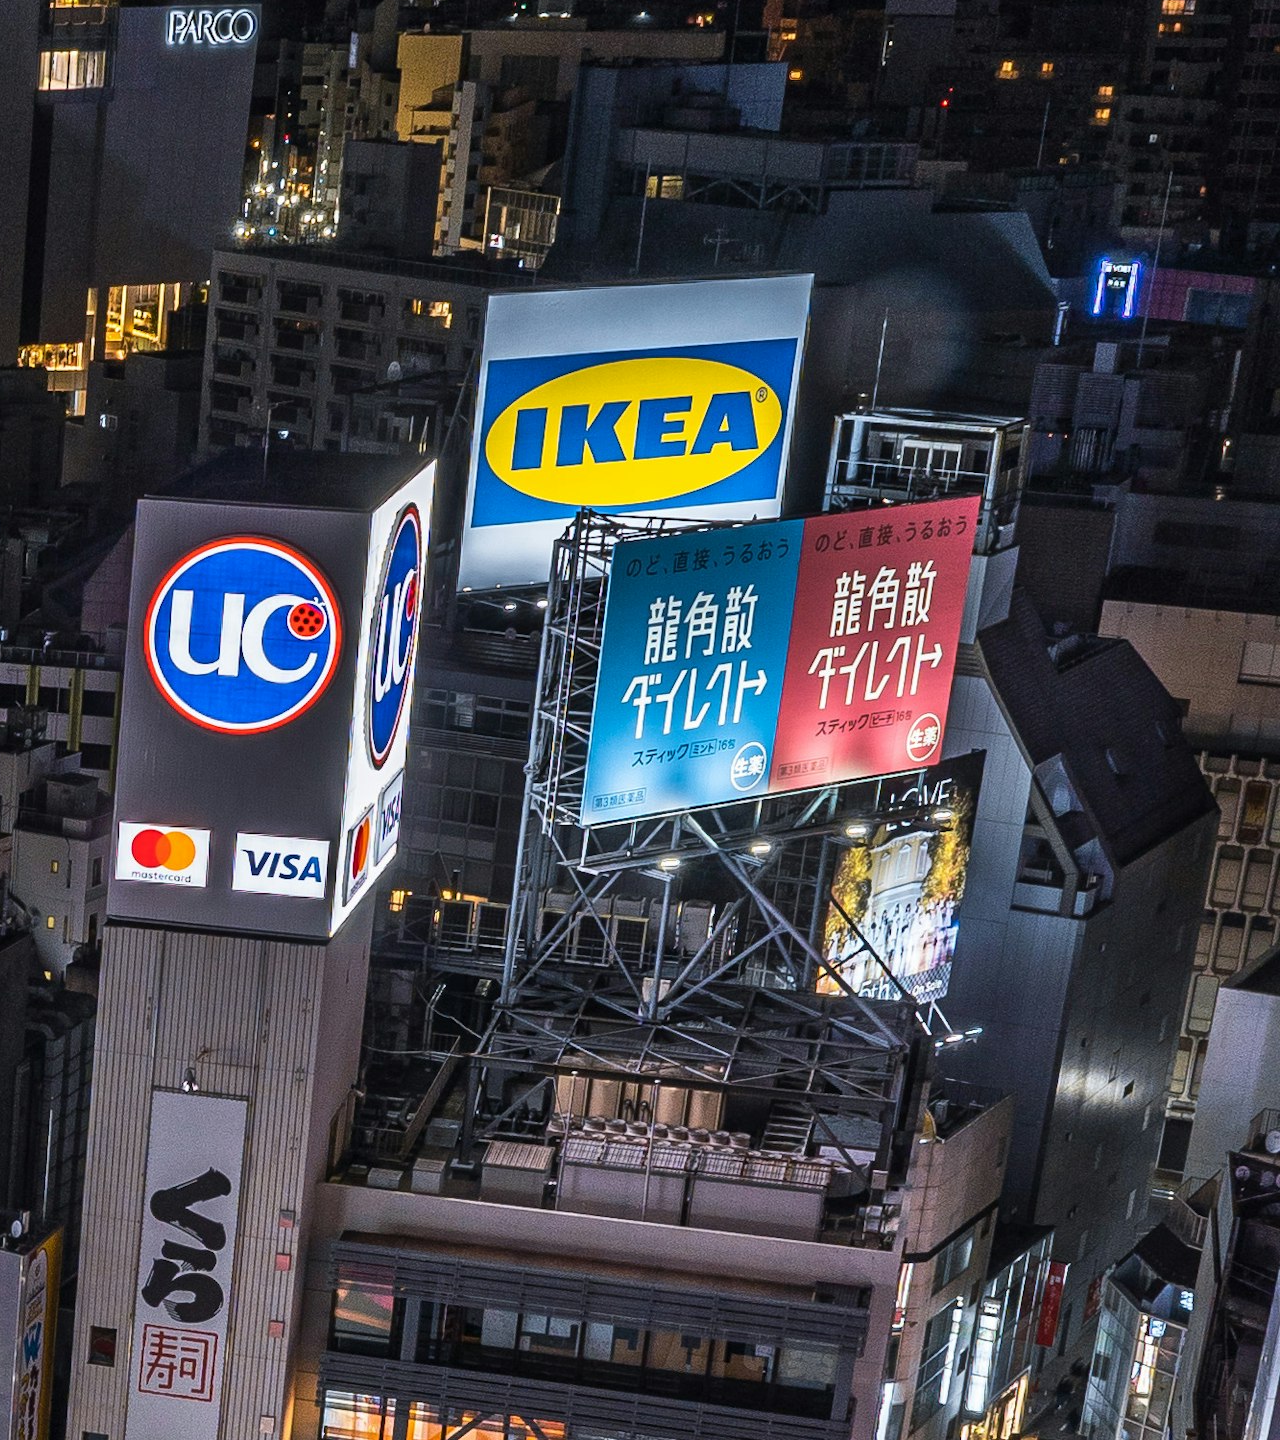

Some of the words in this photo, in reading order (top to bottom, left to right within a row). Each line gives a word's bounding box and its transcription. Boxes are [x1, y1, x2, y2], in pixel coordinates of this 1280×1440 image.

[166, 9, 256, 46] PARCO
[511, 391, 766, 470] IKEA
[815, 515, 968, 553] のど、直接、うるおう
[626, 538, 789, 577] のど、直接、うるおう
[830, 560, 937, 638] 龍角散
[168, 589, 318, 685] UC
[644, 584, 759, 665] 龍角散
[807, 634, 942, 710] ダイレクト
[621, 661, 768, 740] ダイレクト
[815, 714, 869, 737] スティック
[909, 726, 940, 747] 生薬
[632, 743, 689, 767] スティック
[692, 741, 717, 756] ミント
[733, 757, 765, 779] 生薬
[129, 870, 192, 885] mastercard
[243, 850, 323, 884] VISA
[141, 1166, 232, 1324] くら
[144, 1329, 211, 1396] 寿司
